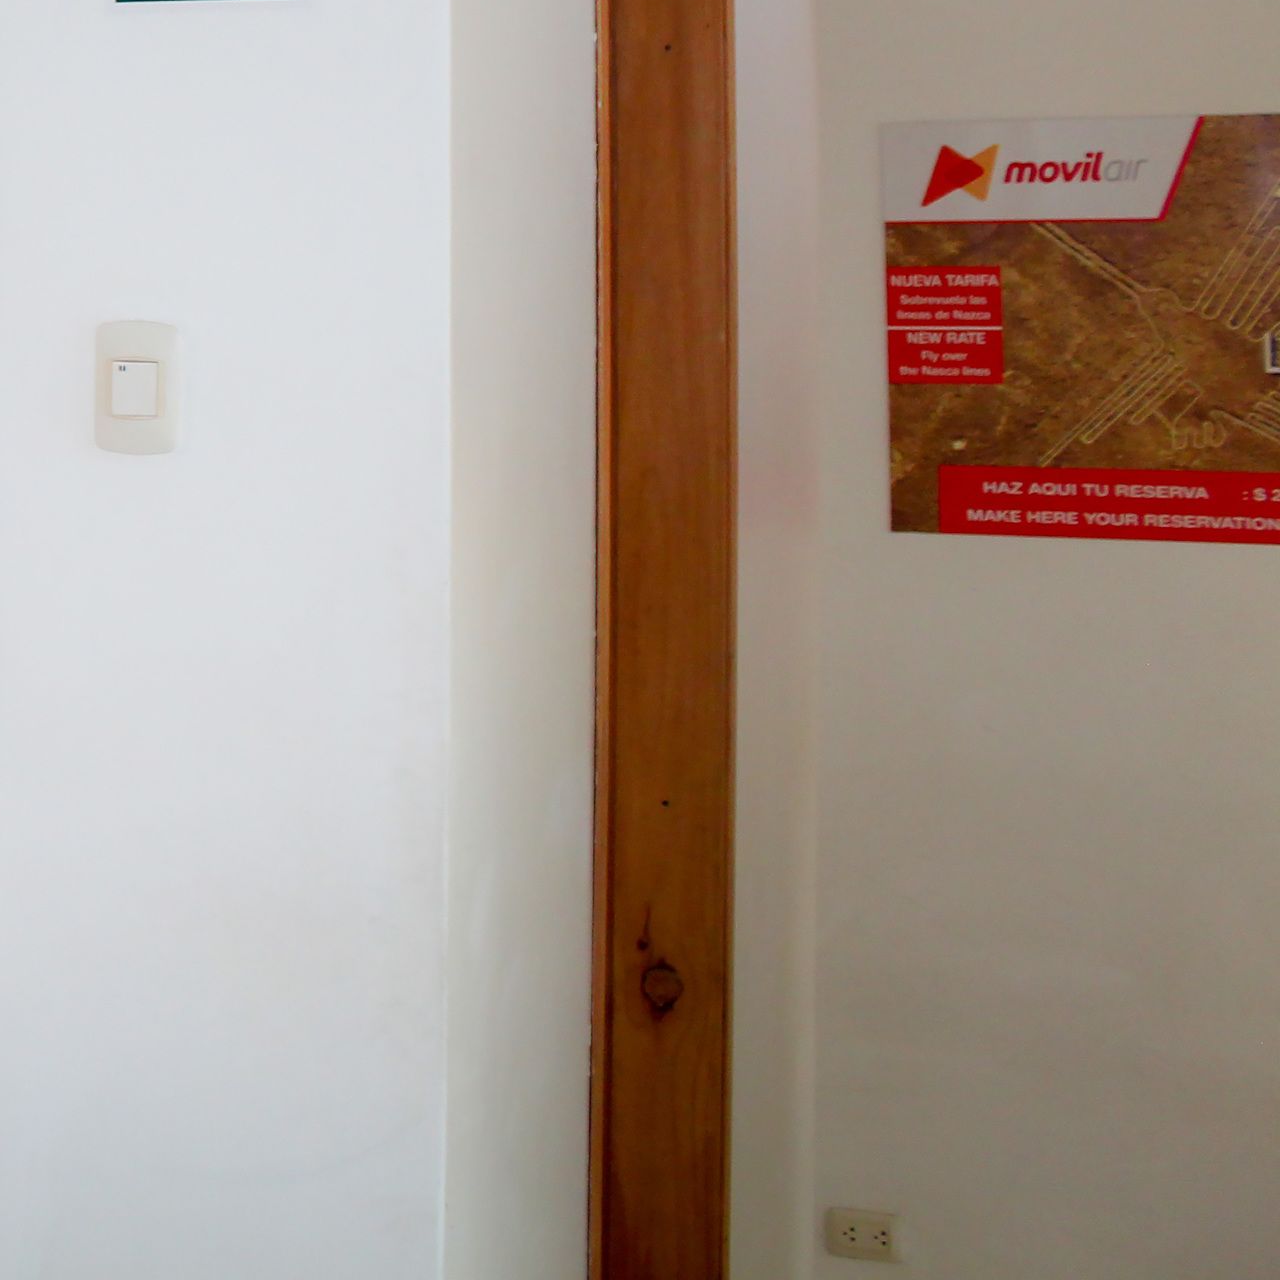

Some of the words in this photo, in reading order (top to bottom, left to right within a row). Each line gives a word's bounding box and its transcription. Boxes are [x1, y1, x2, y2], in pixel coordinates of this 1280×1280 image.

[890, 274, 942, 287] NUEVA
[945, 273, 999, 287] TARIFA
[906, 332, 942, 345] NEW
[945, 331, 986, 345] RATE
[982, 481, 1023, 495] HAZ
[1028, 482, 1077, 496] AQUI
[1082, 483, 1109, 497] TU
[1114, 484, 1209, 499] RESERVA
[966, 508, 1022, 523] MAKE
[1026, 510, 1079, 525] HERE
[1084, 511, 1138, 526] YOUR
